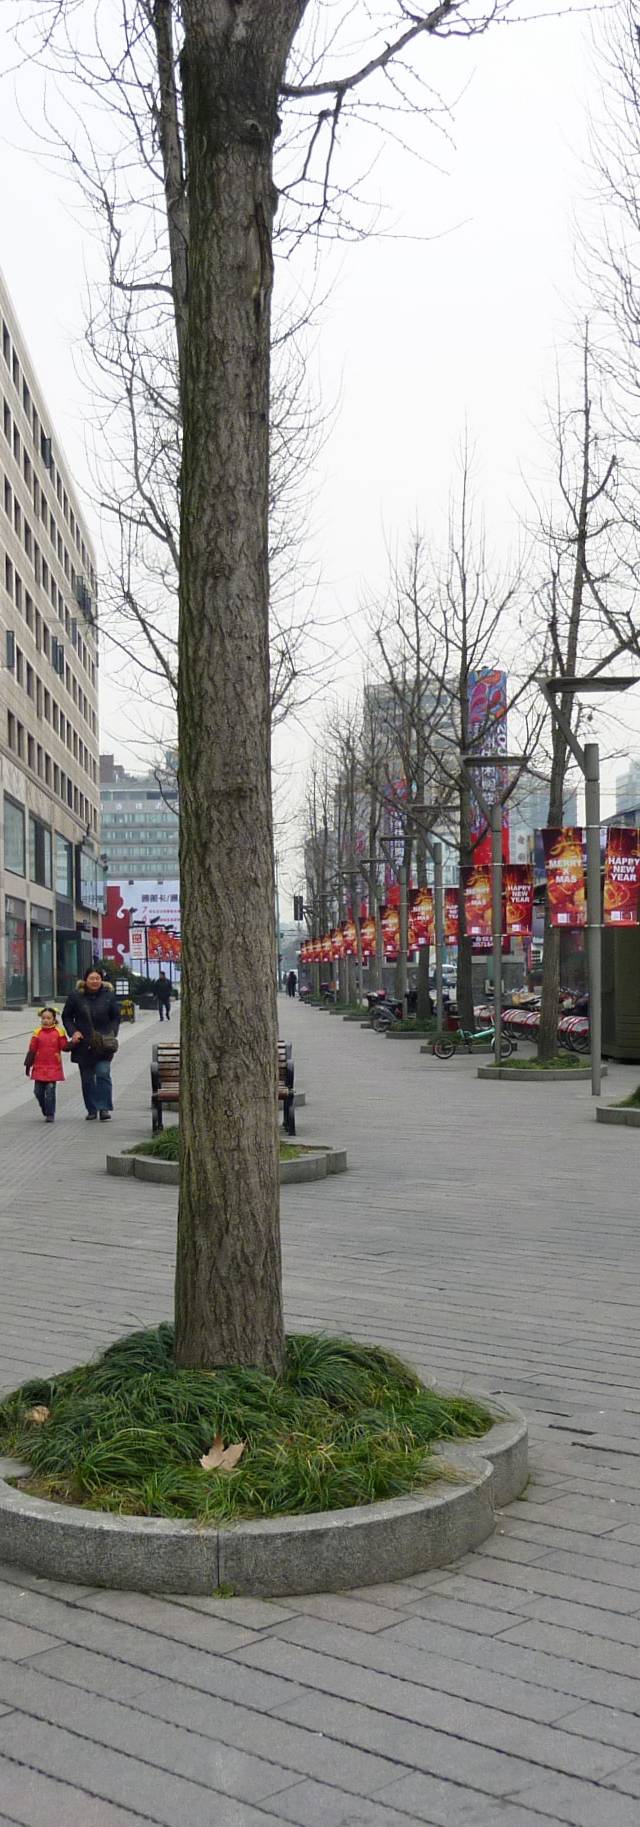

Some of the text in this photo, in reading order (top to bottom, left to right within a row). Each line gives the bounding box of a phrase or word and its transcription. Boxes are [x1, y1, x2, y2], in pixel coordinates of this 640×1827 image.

[549, 858, 581, 869] MERRY
[608, 857, 640, 865] HAPPY
[555, 875, 577, 883] MAS
[611, 873, 636, 881] YEAR
